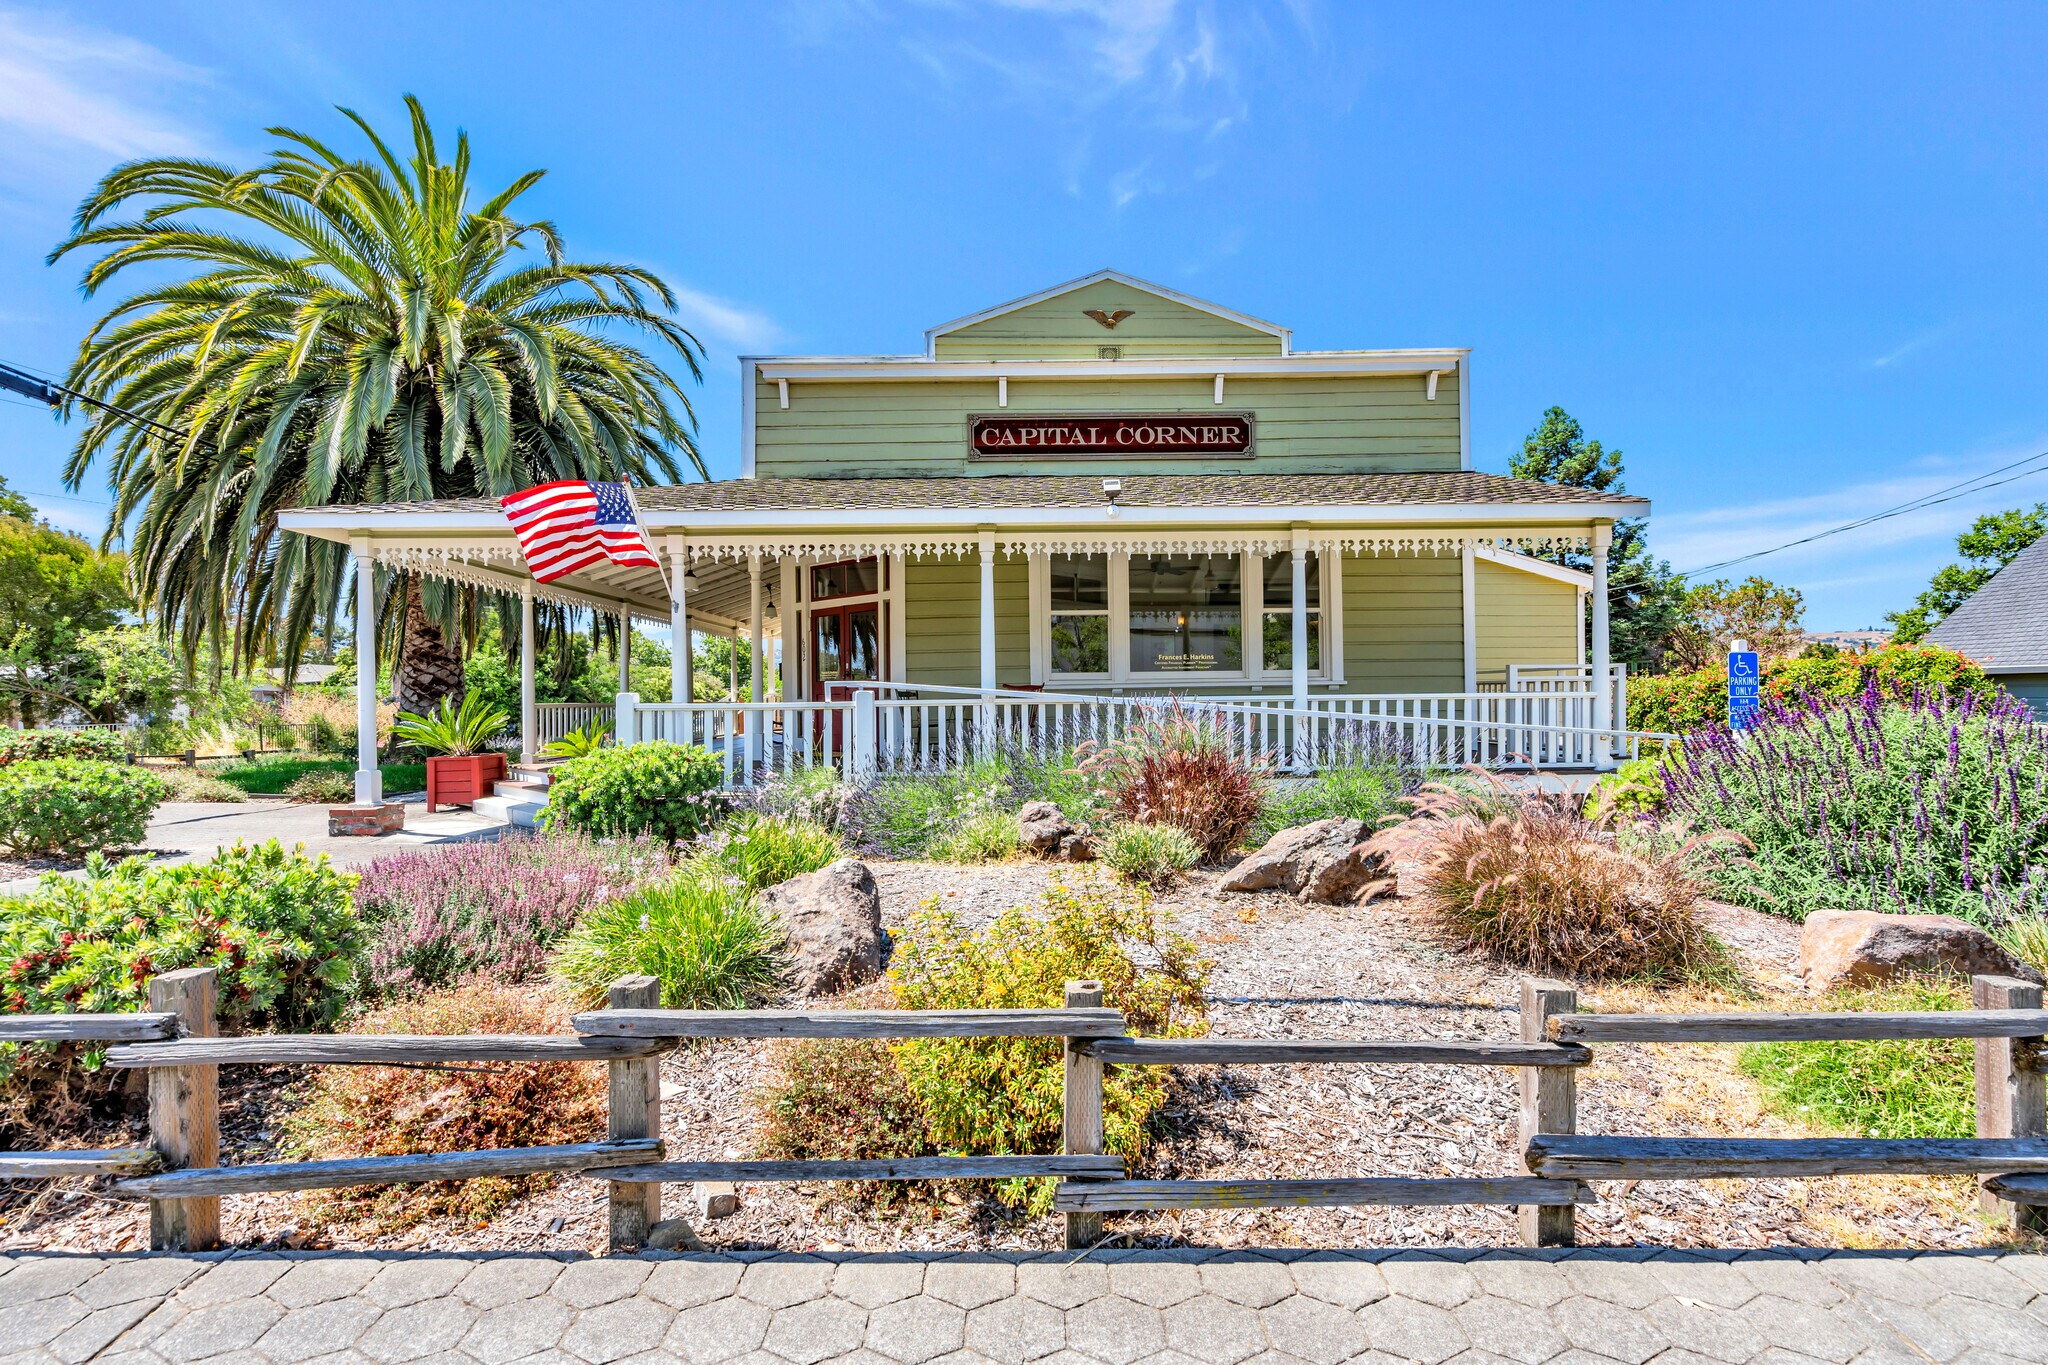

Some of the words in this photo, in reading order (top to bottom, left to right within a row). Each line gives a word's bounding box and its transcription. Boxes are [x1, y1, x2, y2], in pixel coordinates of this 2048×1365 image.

[980, 427, 1107, 446] CAPITAL
[1115, 426, 1242, 445] CORNER
[1730, 676, 1757, 686] PARKING
[1736, 686, 1752, 696] ONLY
